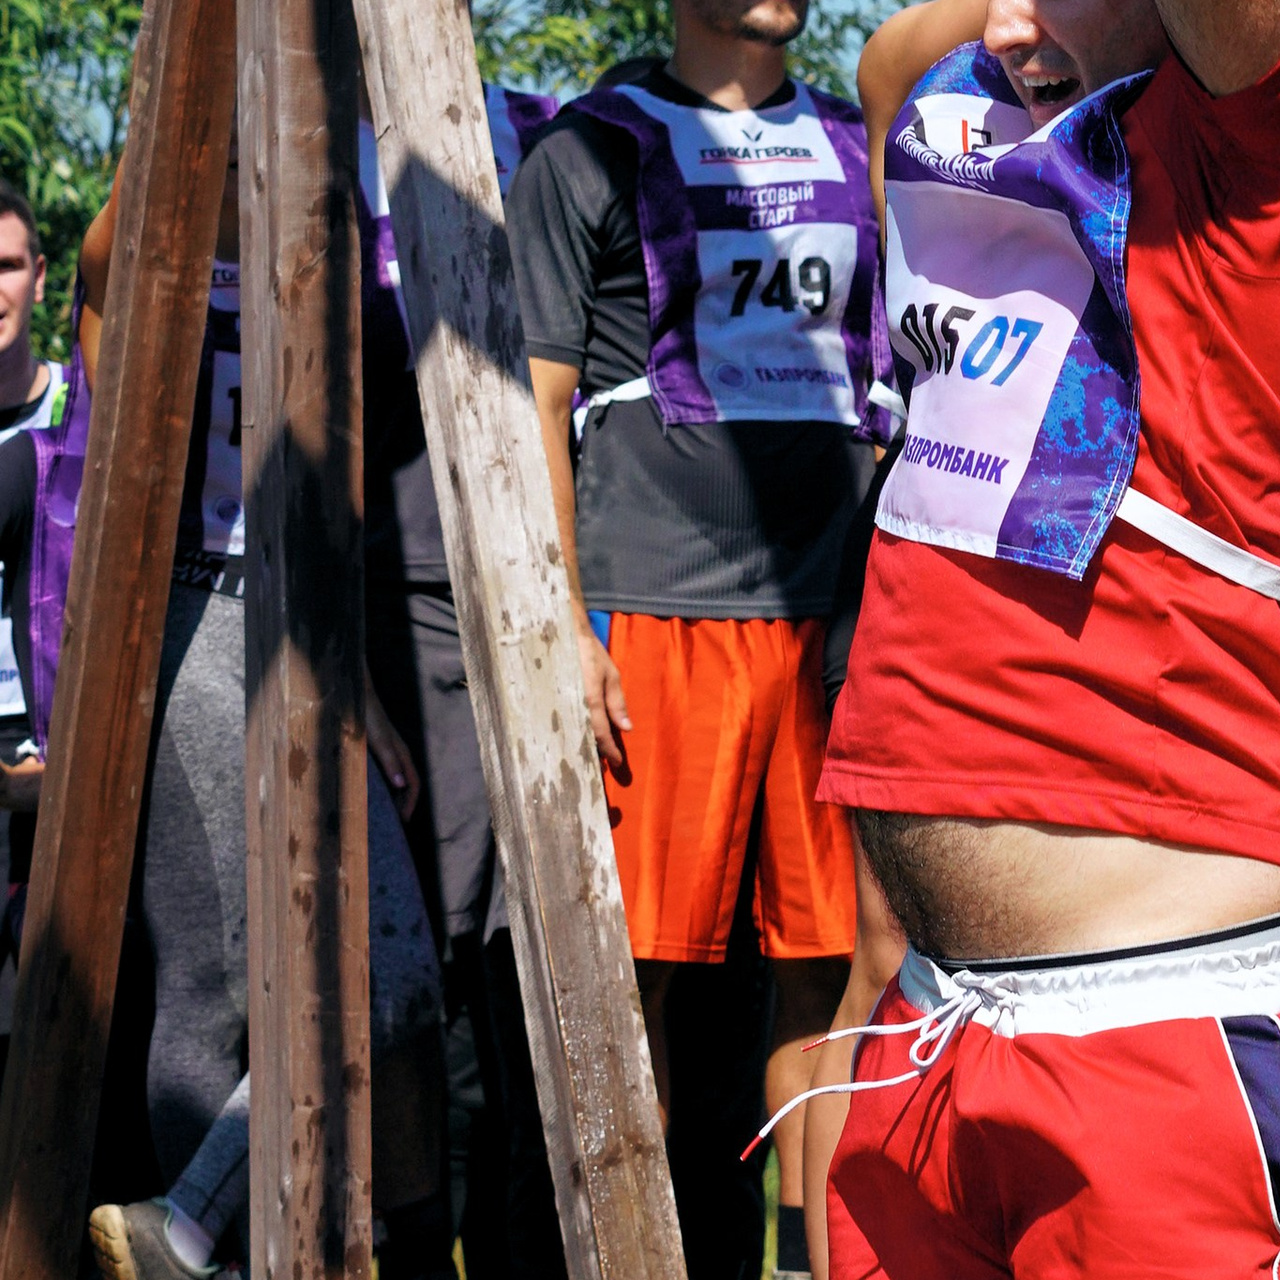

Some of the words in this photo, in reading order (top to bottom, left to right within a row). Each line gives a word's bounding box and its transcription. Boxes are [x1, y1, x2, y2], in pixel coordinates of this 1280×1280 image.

[701, 147, 751, 160] ГОНКА
[755, 146, 813, 159] ГЕРОЕВ
[726, 180, 815, 207] МАССОВЫЙ
[750, 205, 797, 229] СТАРТ
[730, 256, 832, 318] 749
[905, 433, 1010, 485] ЗПРОМБАНК
